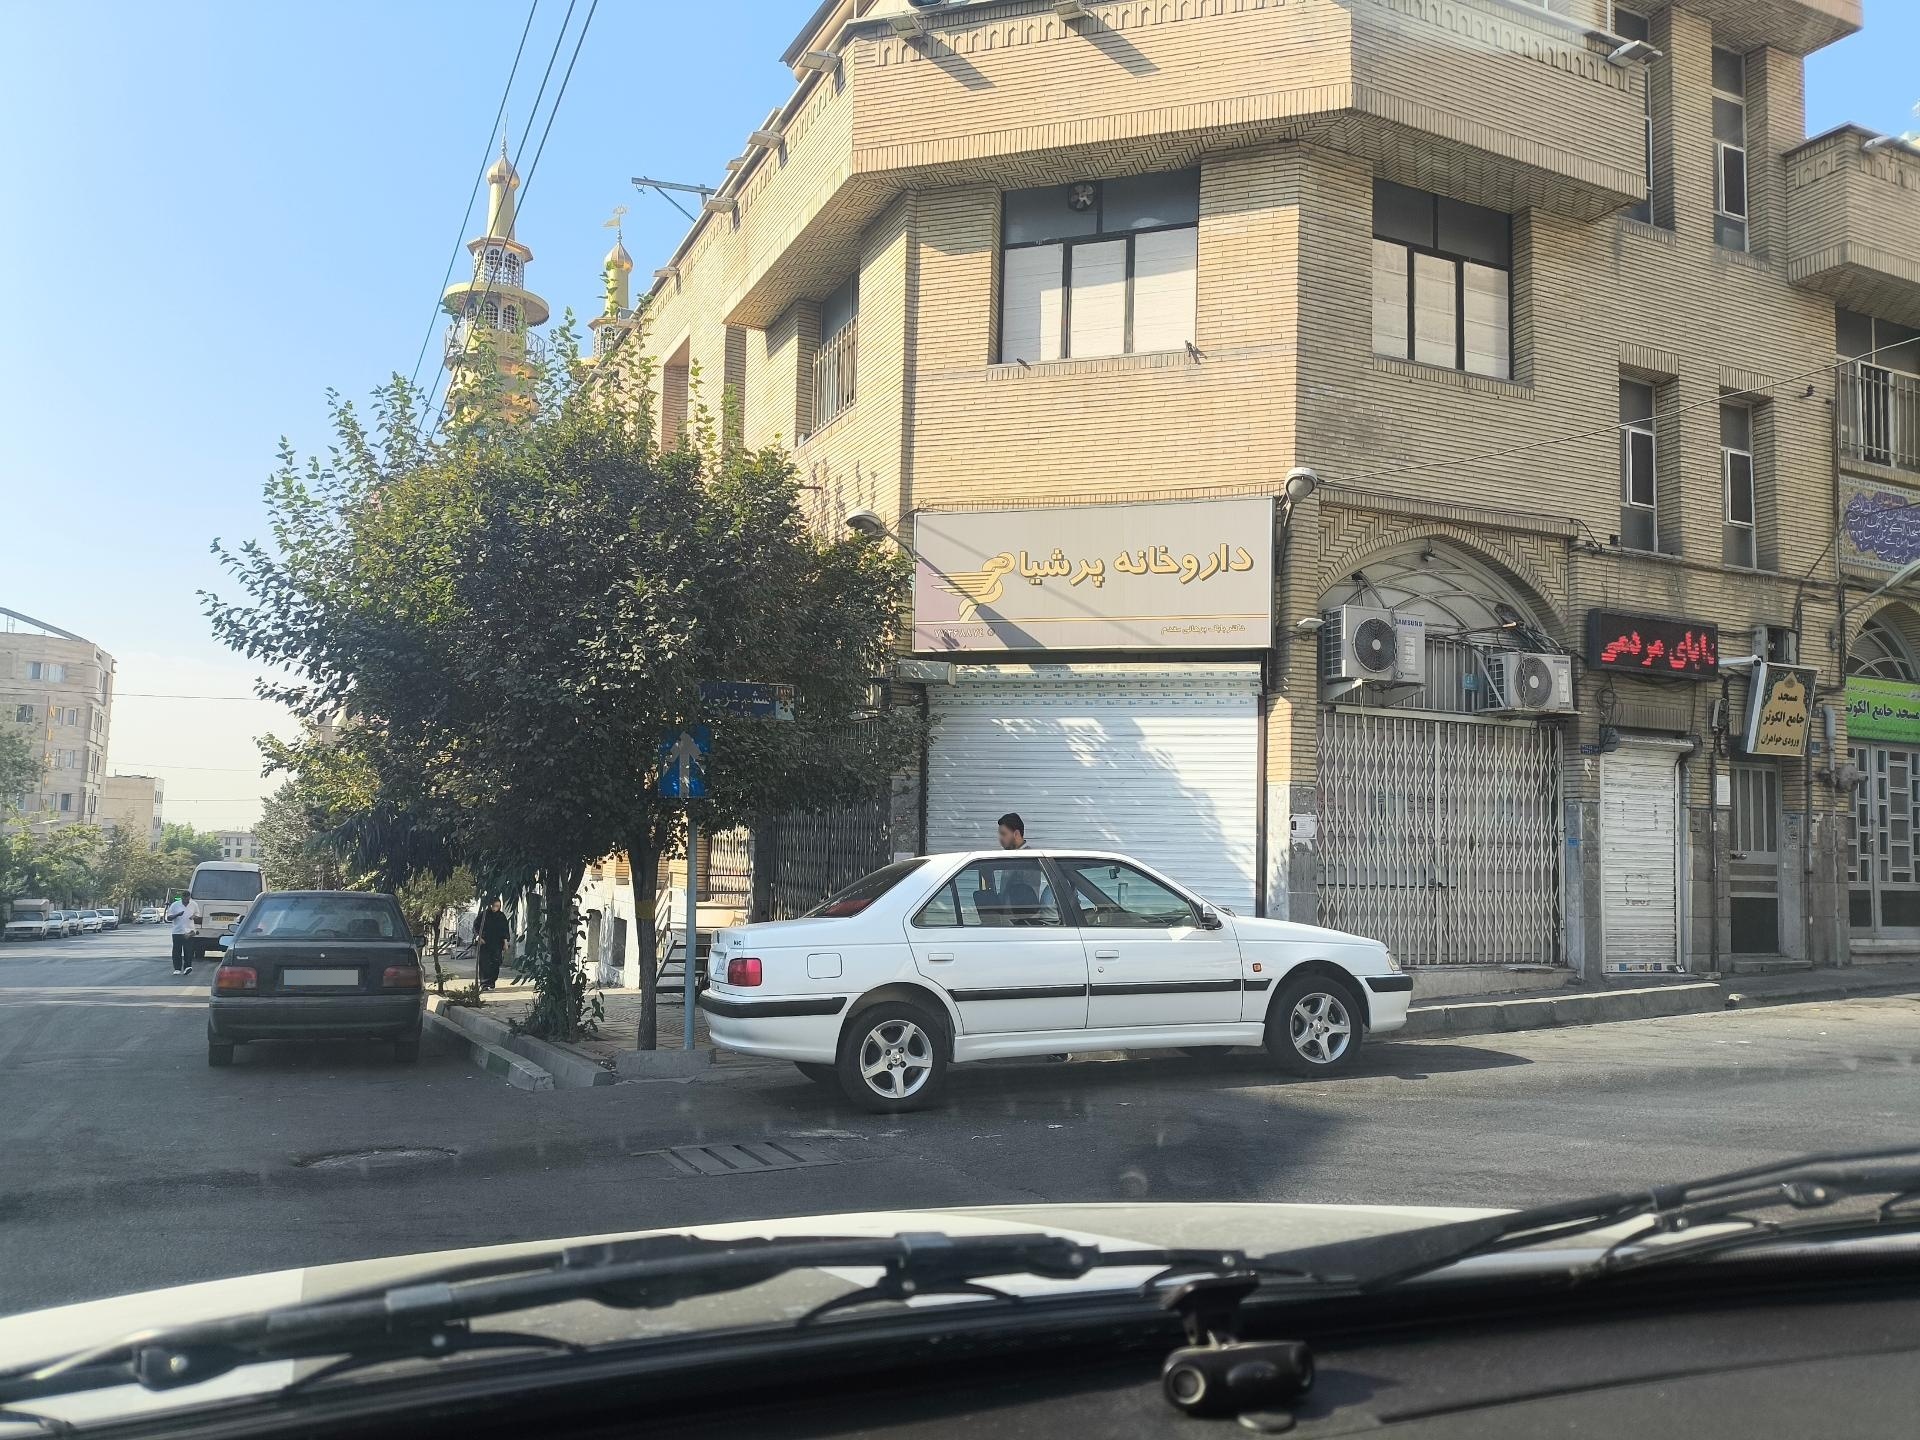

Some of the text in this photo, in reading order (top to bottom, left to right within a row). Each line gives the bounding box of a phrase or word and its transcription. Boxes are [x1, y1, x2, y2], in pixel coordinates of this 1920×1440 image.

[1019, 543, 1254, 588] داروخانه پرشیا
[1777, 692, 1798, 704] مسجد
[1762, 709, 1805, 728] جامع الکوثر
[1871, 703, 1893, 721] جامع
[1895, 708, 1920, 723] مسجد
[1760, 733, 1800, 747] ورودی خواهران
